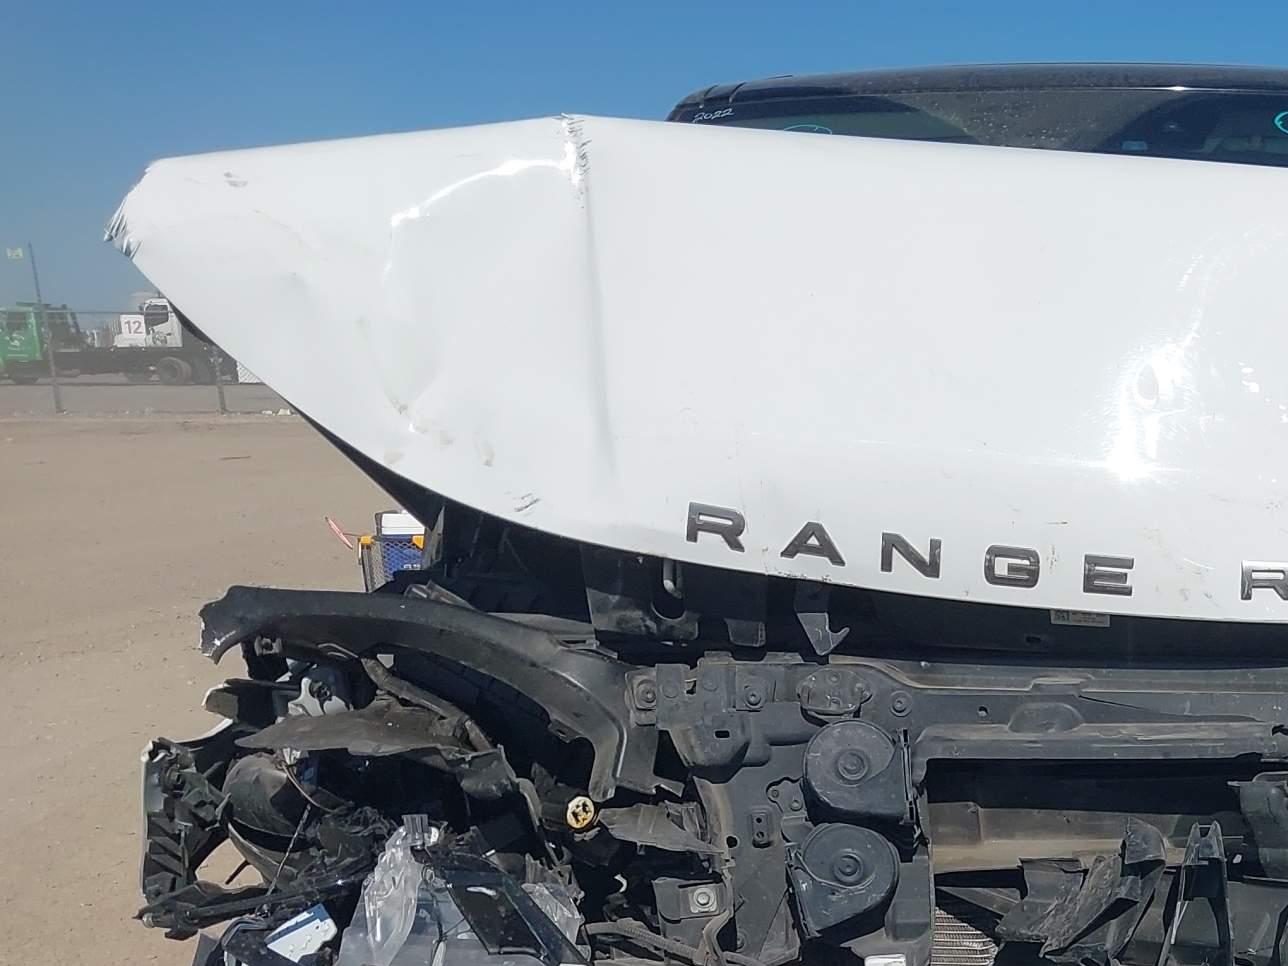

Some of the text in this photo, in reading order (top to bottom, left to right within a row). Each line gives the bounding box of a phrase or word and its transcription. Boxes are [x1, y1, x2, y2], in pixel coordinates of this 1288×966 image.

[692, 107, 735, 123] 2022
[124, 319, 144, 335] 12
[685, 500, 1136, 598] RANGE
